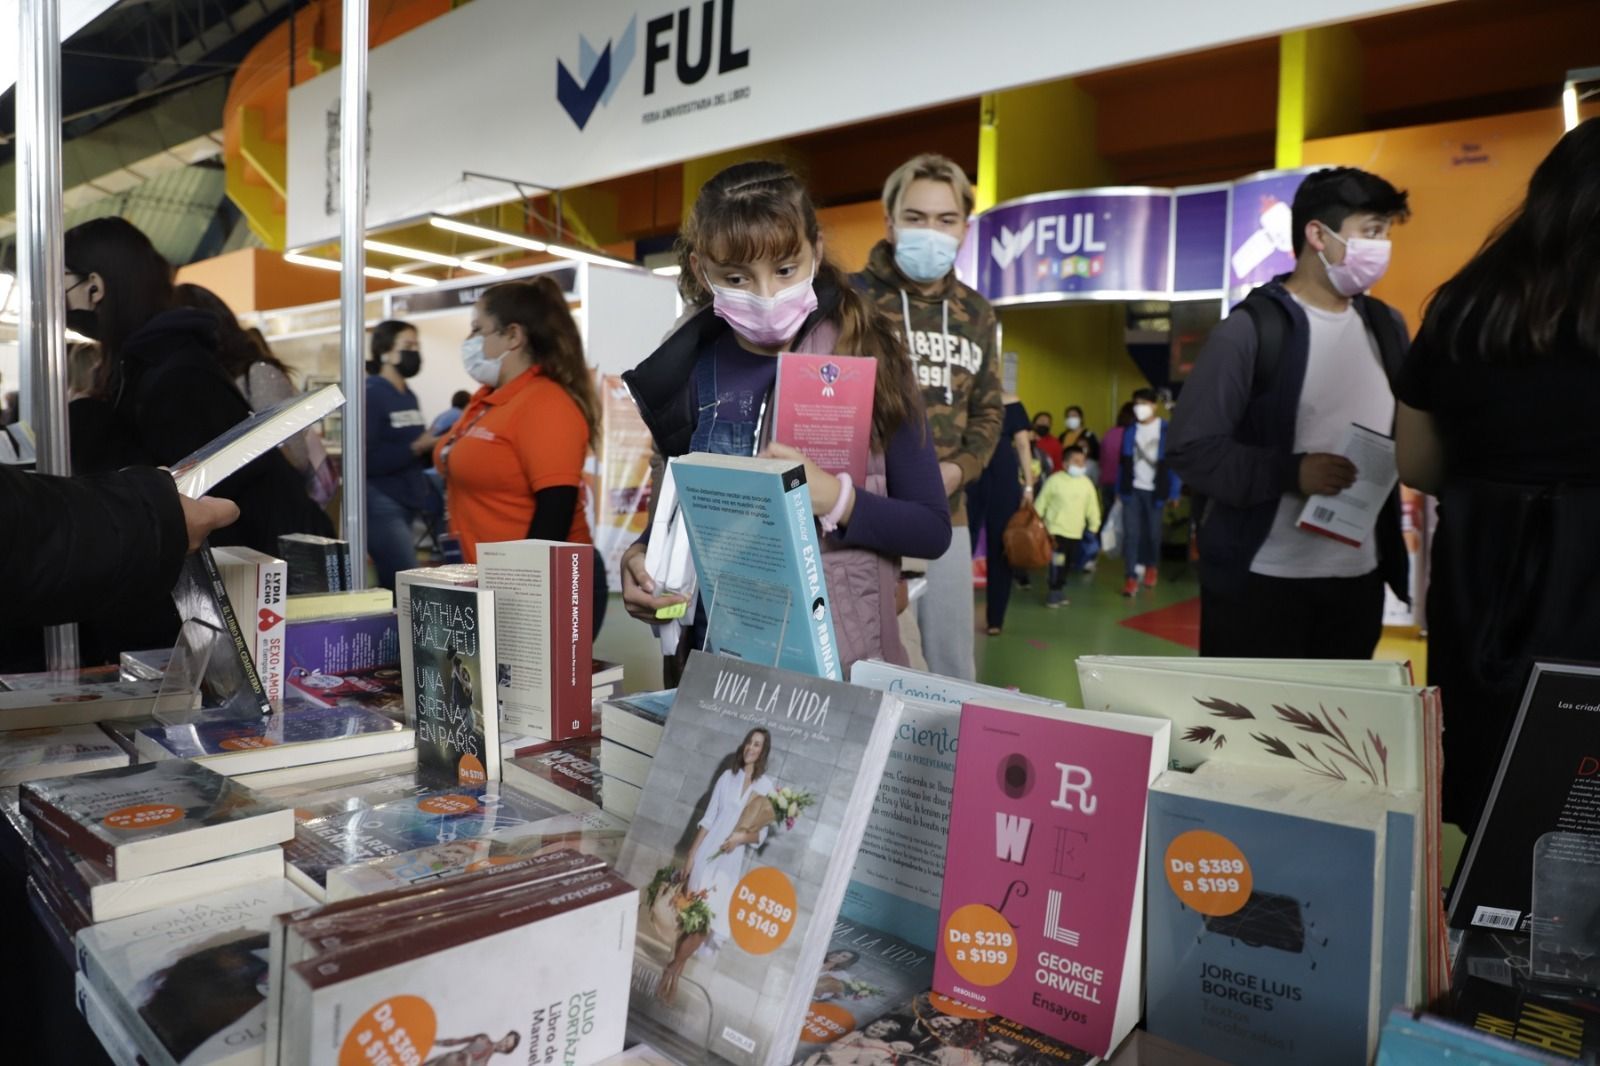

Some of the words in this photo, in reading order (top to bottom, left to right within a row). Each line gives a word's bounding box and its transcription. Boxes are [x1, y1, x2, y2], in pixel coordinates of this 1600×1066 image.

[643, 0, 750, 97] FUL
[1035, 212, 1106, 255] FUL
[908, 330, 983, 376] &BEAR
[264, 572, 272, 605] CACHO
[272, 572, 281, 605] LYDIA
[802, 544, 821, 599] EXTRA
[411, 600, 475, 631] MATHIAS
[571, 609, 579, 643] MICHAEL
[269, 637, 281, 667] SEXO
[412, 622, 476, 657] MALZIEU
[239, 649, 262, 695] CEMENTERIO
[268, 672, 280, 703] AMOR
[416, 667, 447, 694] UNA
[417, 693, 467, 729] SIRENA
[712, 669, 752, 707] VIVA
[755, 681, 781, 714] LA
[786, 687, 831, 728] VIDA
[1557, 700, 1573, 711] Las
[418, 720, 438, 745] EN
[108, 814, 132, 824] De
[1170, 857, 1195, 873] De
[1198, 858, 1244, 874] $389
[1182, 879, 1194, 892] a
[1196, 878, 1240, 893] $199
[737, 885, 755, 905] De
[756, 896, 793, 924] $399
[735, 908, 746, 923] a
[746, 911, 780, 938] $149
[949, 928, 971, 944] De
[975, 930, 1013, 947] $219
[956, 949, 966, 961] a
[969, 948, 1009, 965] $199
[1037, 950, 1104, 986] GEORGE
[1035, 968, 1102, 1005] ORWELL
[1199, 961, 1257, 991] JORGE
[1260, 977, 1303, 1001] LUIS
[1201, 979, 1274, 1013] BORGES
[373, 1004, 395, 1033] De
[544, 1001, 564, 1042] Libro
[581, 988, 598, 1036] JULIO
[1031, 991, 1088, 1026] Ensayos
[357, 1030, 373, 1045] a
[563, 993, 583, 1066] CORTÁZA
[542, 1043, 556, 1065] de
